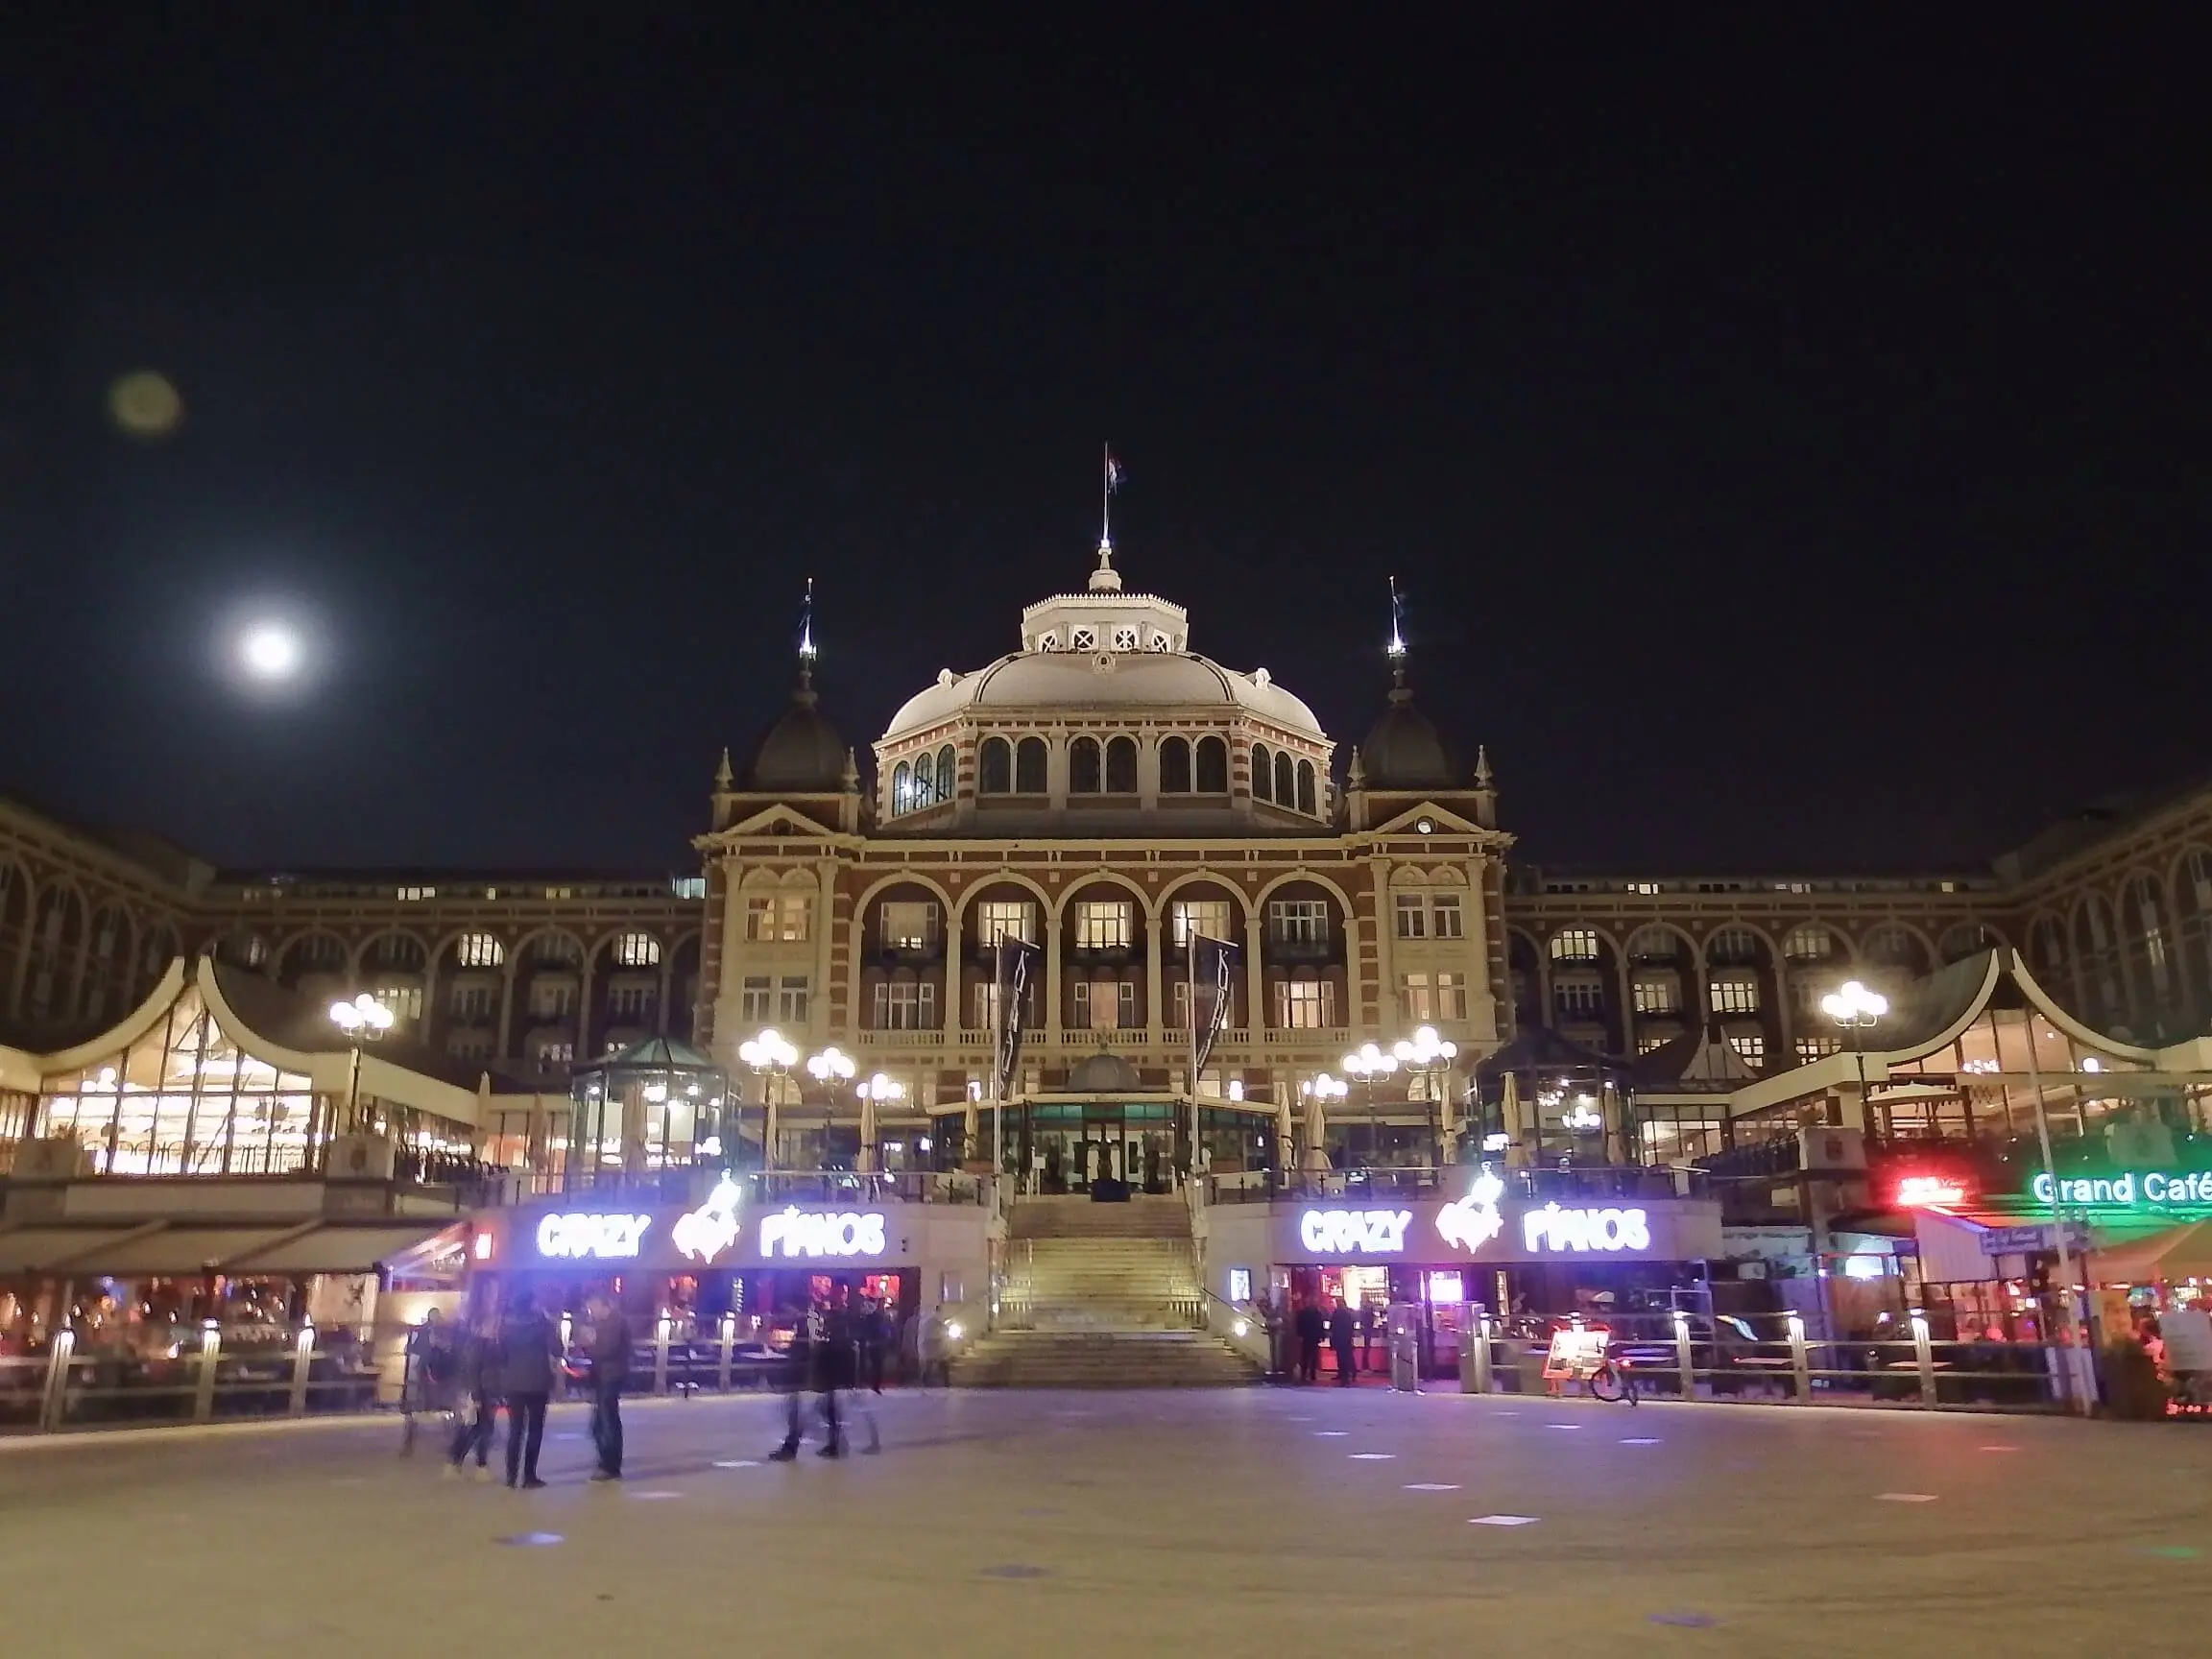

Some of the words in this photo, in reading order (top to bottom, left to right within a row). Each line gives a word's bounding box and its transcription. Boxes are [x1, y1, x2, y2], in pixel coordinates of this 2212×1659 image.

[2032, 1172, 2135, 1202] Grand
[2143, 1170, 2212, 1202] Café
[538, 1213, 652, 1259] CRAZY
[760, 1204, 886, 1257] PIANOS
[1300, 1209, 1412, 1253] CRAZY
[1523, 1200, 1651, 1253] PIANOS
